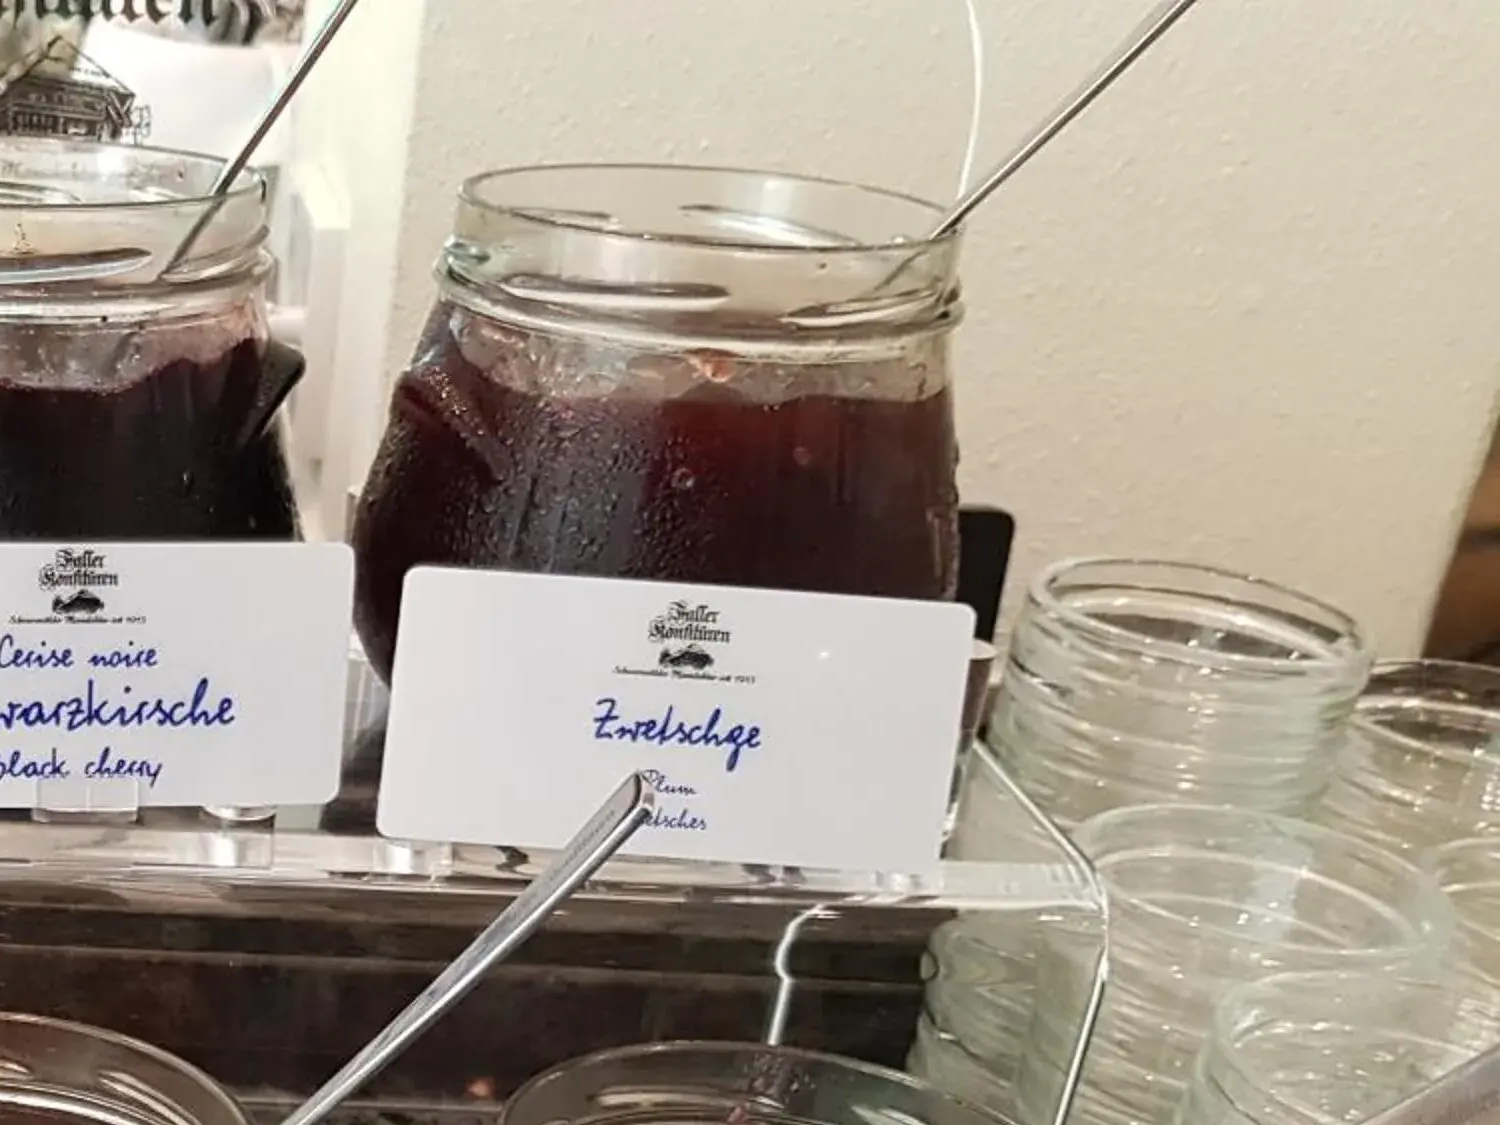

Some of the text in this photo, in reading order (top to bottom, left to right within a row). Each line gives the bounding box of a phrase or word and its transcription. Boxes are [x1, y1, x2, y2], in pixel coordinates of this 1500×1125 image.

[54, 548, 106, 570] Faller
[86, 639, 159, 669] noire
[593, 697, 761, 772] Zwetschge
[83, 745, 164, 789] cherry
